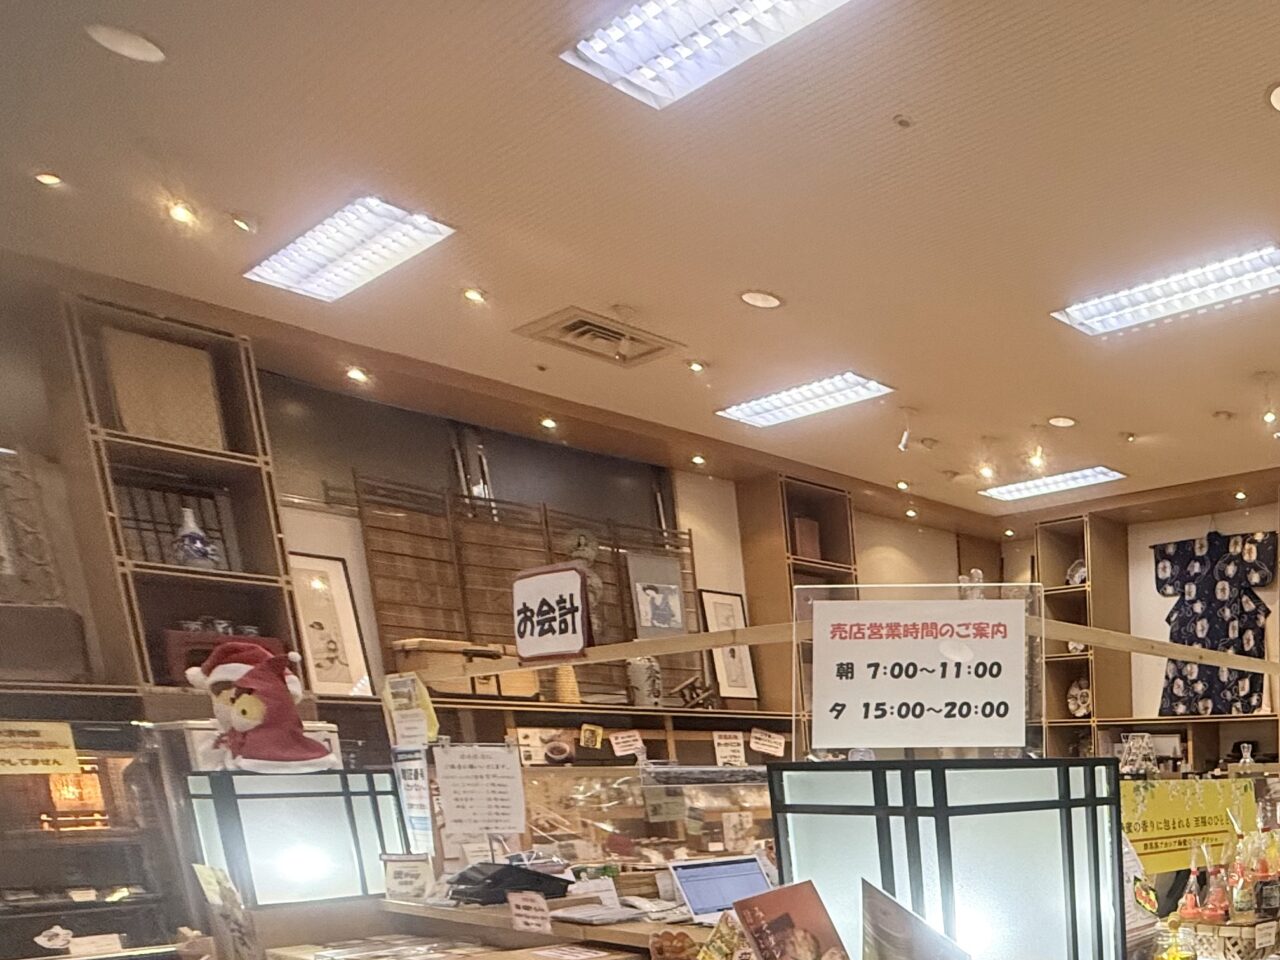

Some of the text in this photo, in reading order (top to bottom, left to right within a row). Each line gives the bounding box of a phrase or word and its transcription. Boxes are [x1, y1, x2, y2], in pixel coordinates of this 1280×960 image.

[516, 593, 579, 639] お会計
[830, 622, 1008, 640] 売店営業時間のご案内
[836, 662, 854, 680] 朝
[829, 702, 846, 719] 夕
